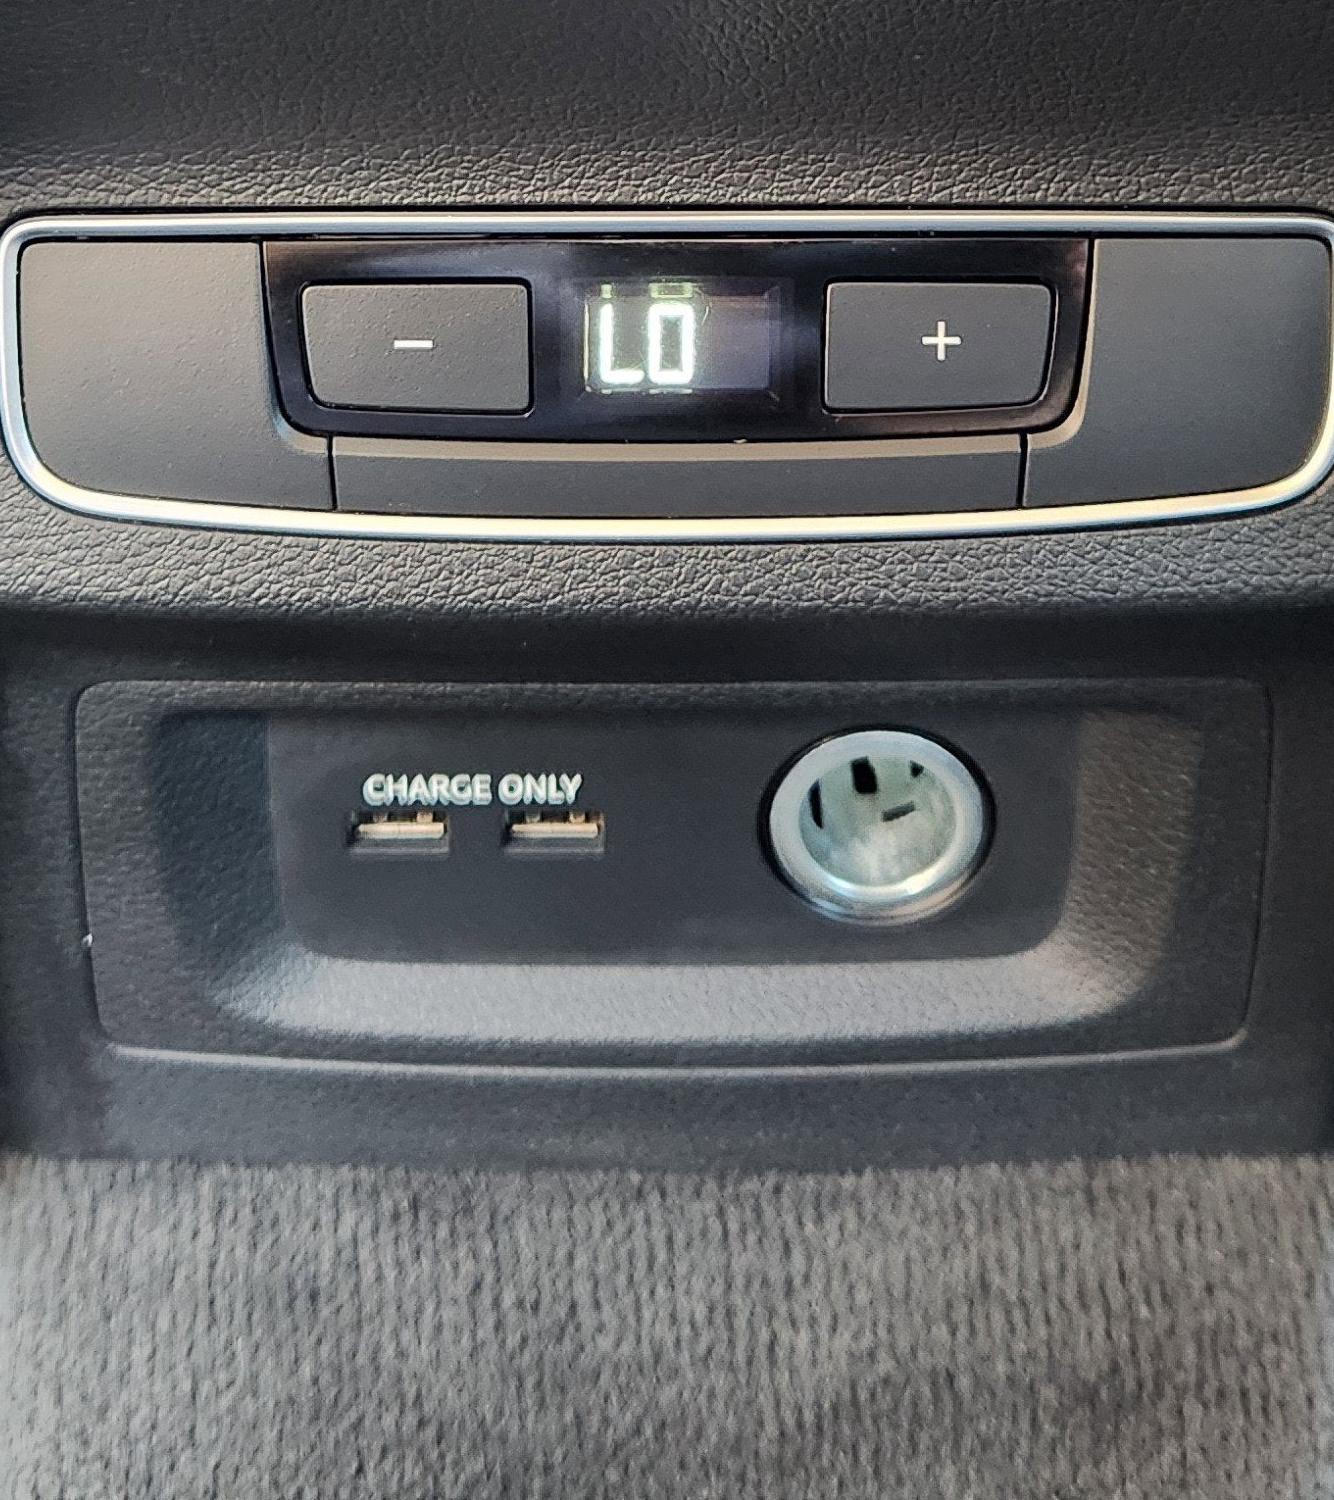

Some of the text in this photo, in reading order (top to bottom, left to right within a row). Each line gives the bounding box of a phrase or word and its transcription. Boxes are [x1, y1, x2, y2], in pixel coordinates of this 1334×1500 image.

[599, 302, 696, 385] LO
[362, 772, 583, 806] CHARGE ONLY
